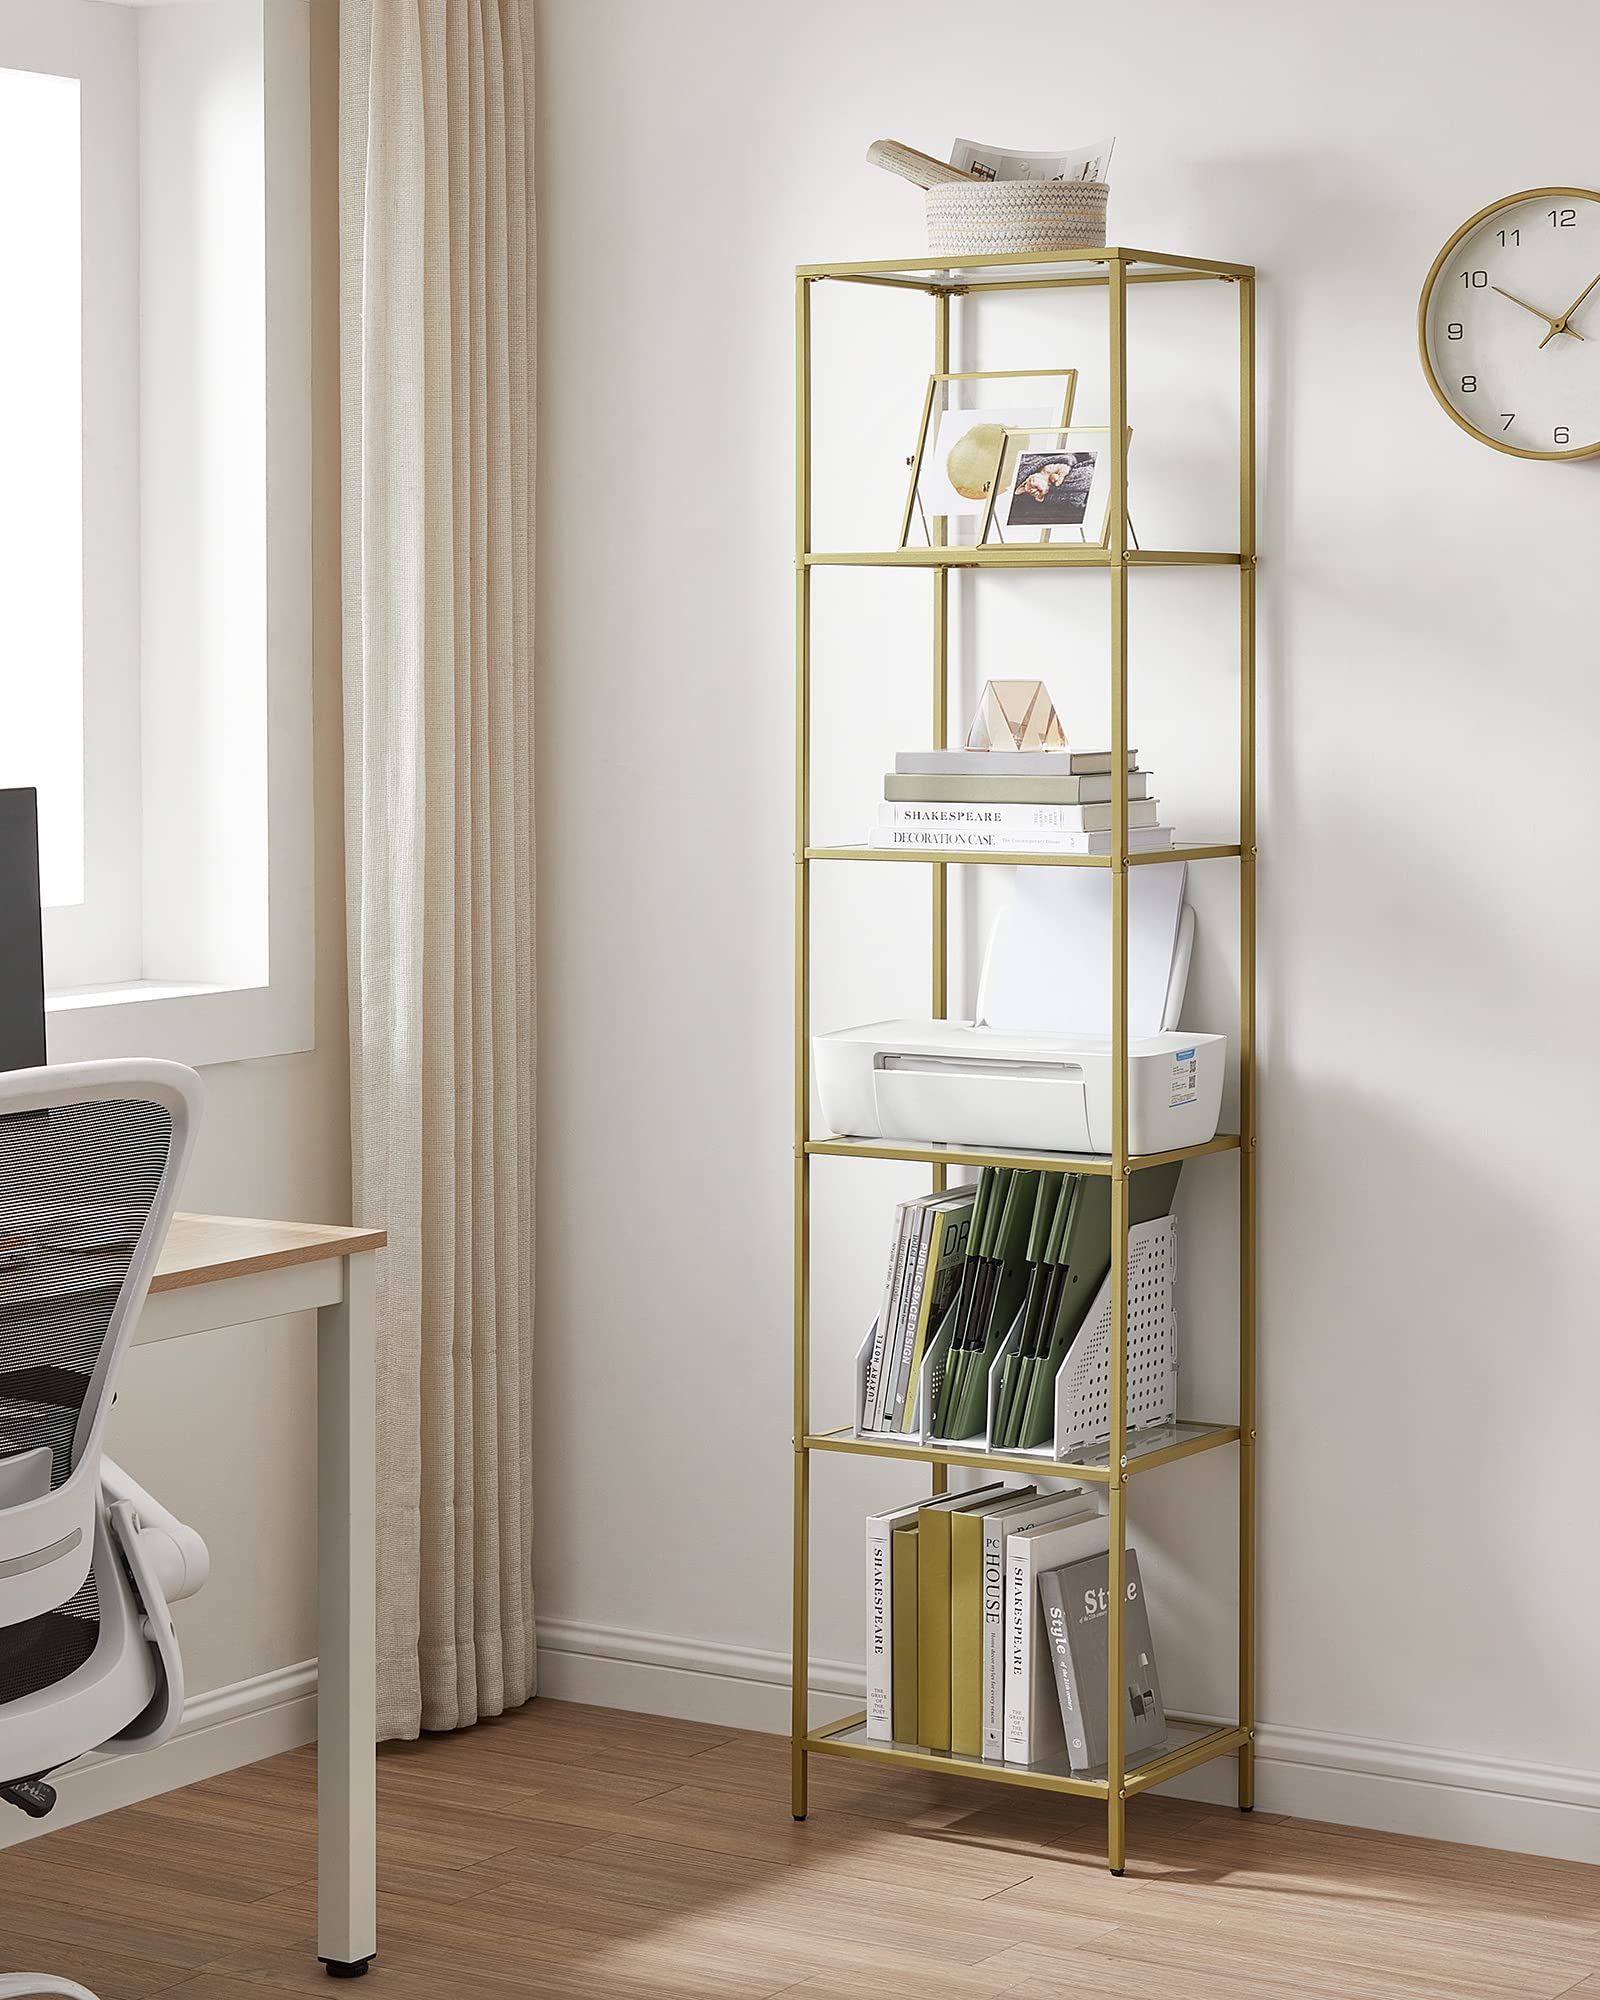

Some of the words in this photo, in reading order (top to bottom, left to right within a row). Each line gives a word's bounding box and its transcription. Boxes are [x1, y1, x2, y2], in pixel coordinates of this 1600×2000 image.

[1548, 210, 1576, 227] 12
[1496, 230, 1520, 247] 11
[1460, 271, 1488, 288] 10
[1448, 323, 1463, 340] 9
[1461, 376, 1477, 392] 8
[1501, 414, 1515, 430] 7
[1554, 427, 1569, 444] 6
[904, 811, 1001, 822] SHAKESPEARE
[894, 832, 965, 844] DECORATION
[968, 835, 995, 845] CASE
[915, 1242, 927, 1283] PUBLIC
[909, 1285, 921, 1321] SPACE
[902, 1322, 915, 1364] DESIGN
[868, 1368, 878, 1403] LUXYRY
[874, 1334, 884, 1363] HOTEL
[986, 1539, 1000, 1548] PC
[986, 1553, 1000, 1624] HOUSE
[874, 1548, 883, 1654] SHAKESPEARE
[1085, 1582, 1137, 1614] Ste
[1014, 1567, 1023, 1675] SHAKESPEARE
[1050, 1607, 1067, 1654] Style
